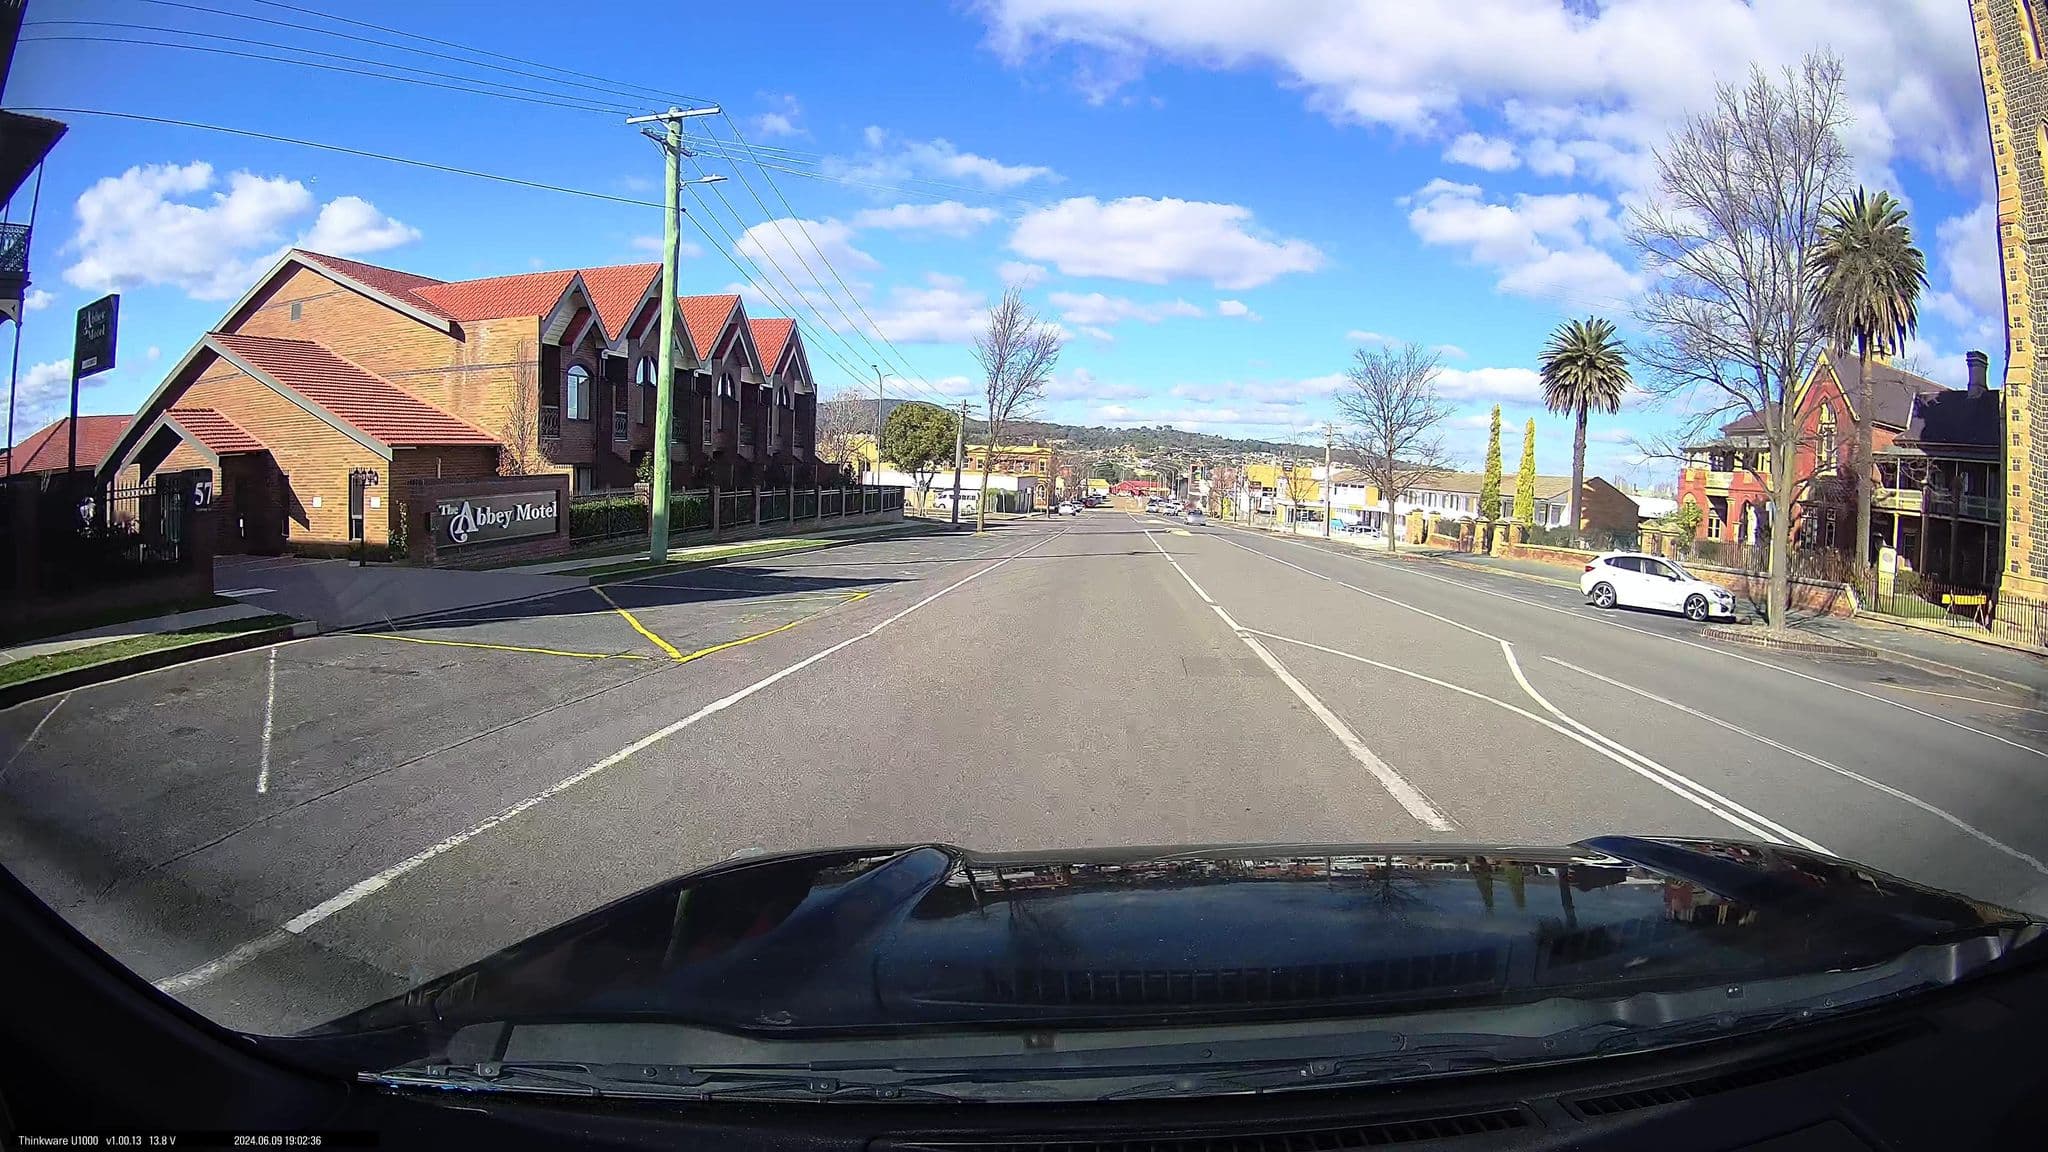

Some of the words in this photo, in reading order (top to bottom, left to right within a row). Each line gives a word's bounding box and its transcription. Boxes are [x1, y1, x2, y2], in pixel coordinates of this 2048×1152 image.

[195, 482, 212, 505] 57
[439, 504, 458, 515] The
[450, 501, 513, 542] Abbey
[516, 502, 557, 520] Motel
